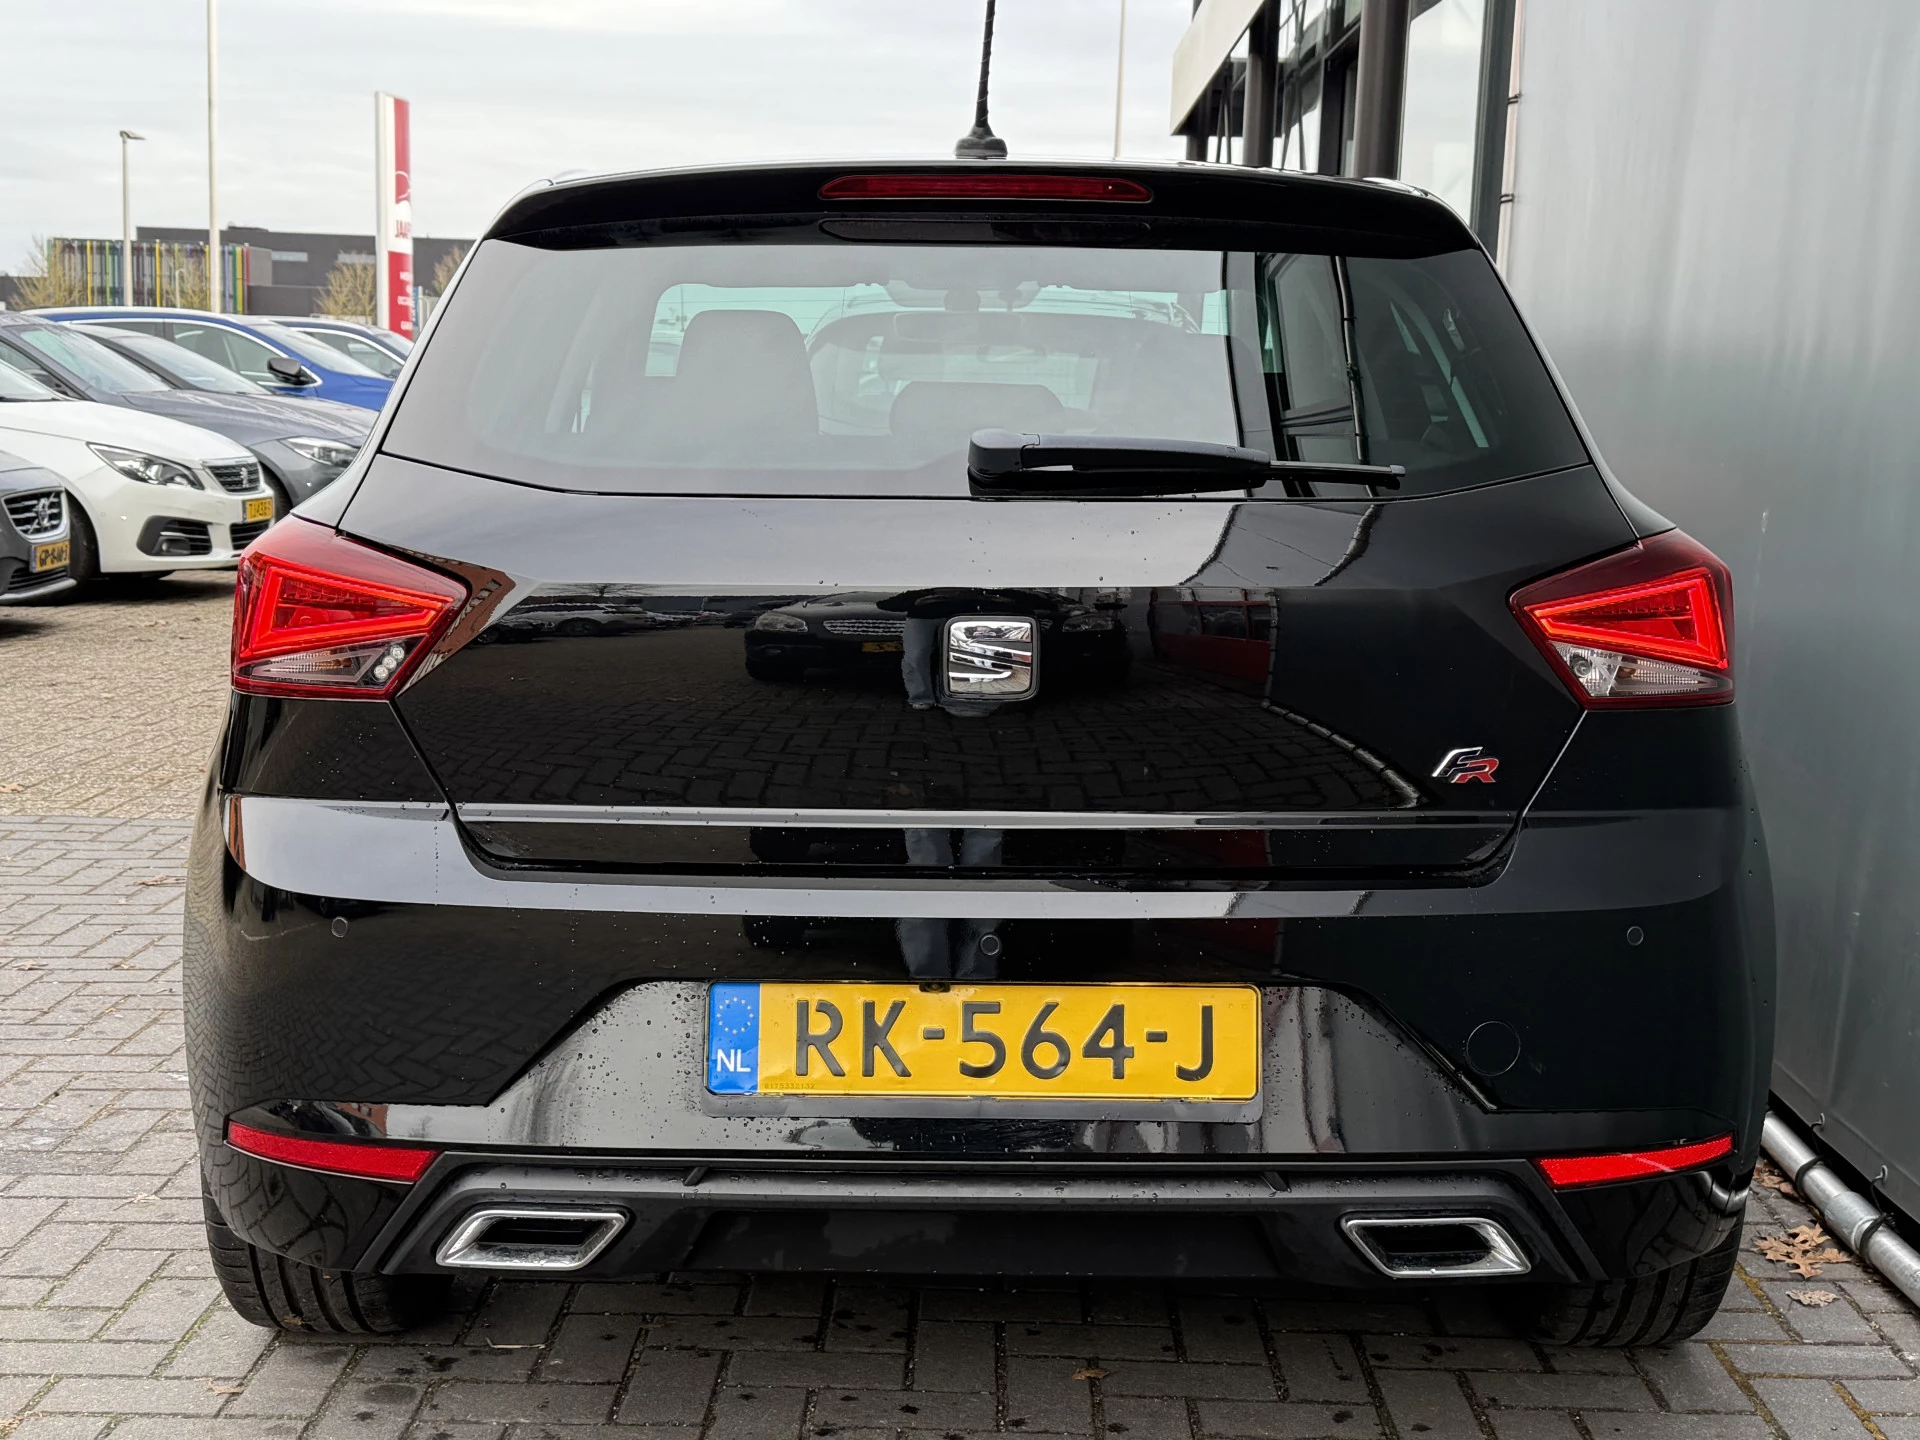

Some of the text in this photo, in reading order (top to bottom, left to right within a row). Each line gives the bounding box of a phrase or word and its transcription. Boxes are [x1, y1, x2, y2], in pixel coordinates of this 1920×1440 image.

[1431, 746, 1499, 784] FR
[795, 998, 1215, 1083] RK-564-J
[716, 1048, 751, 1073] NL
